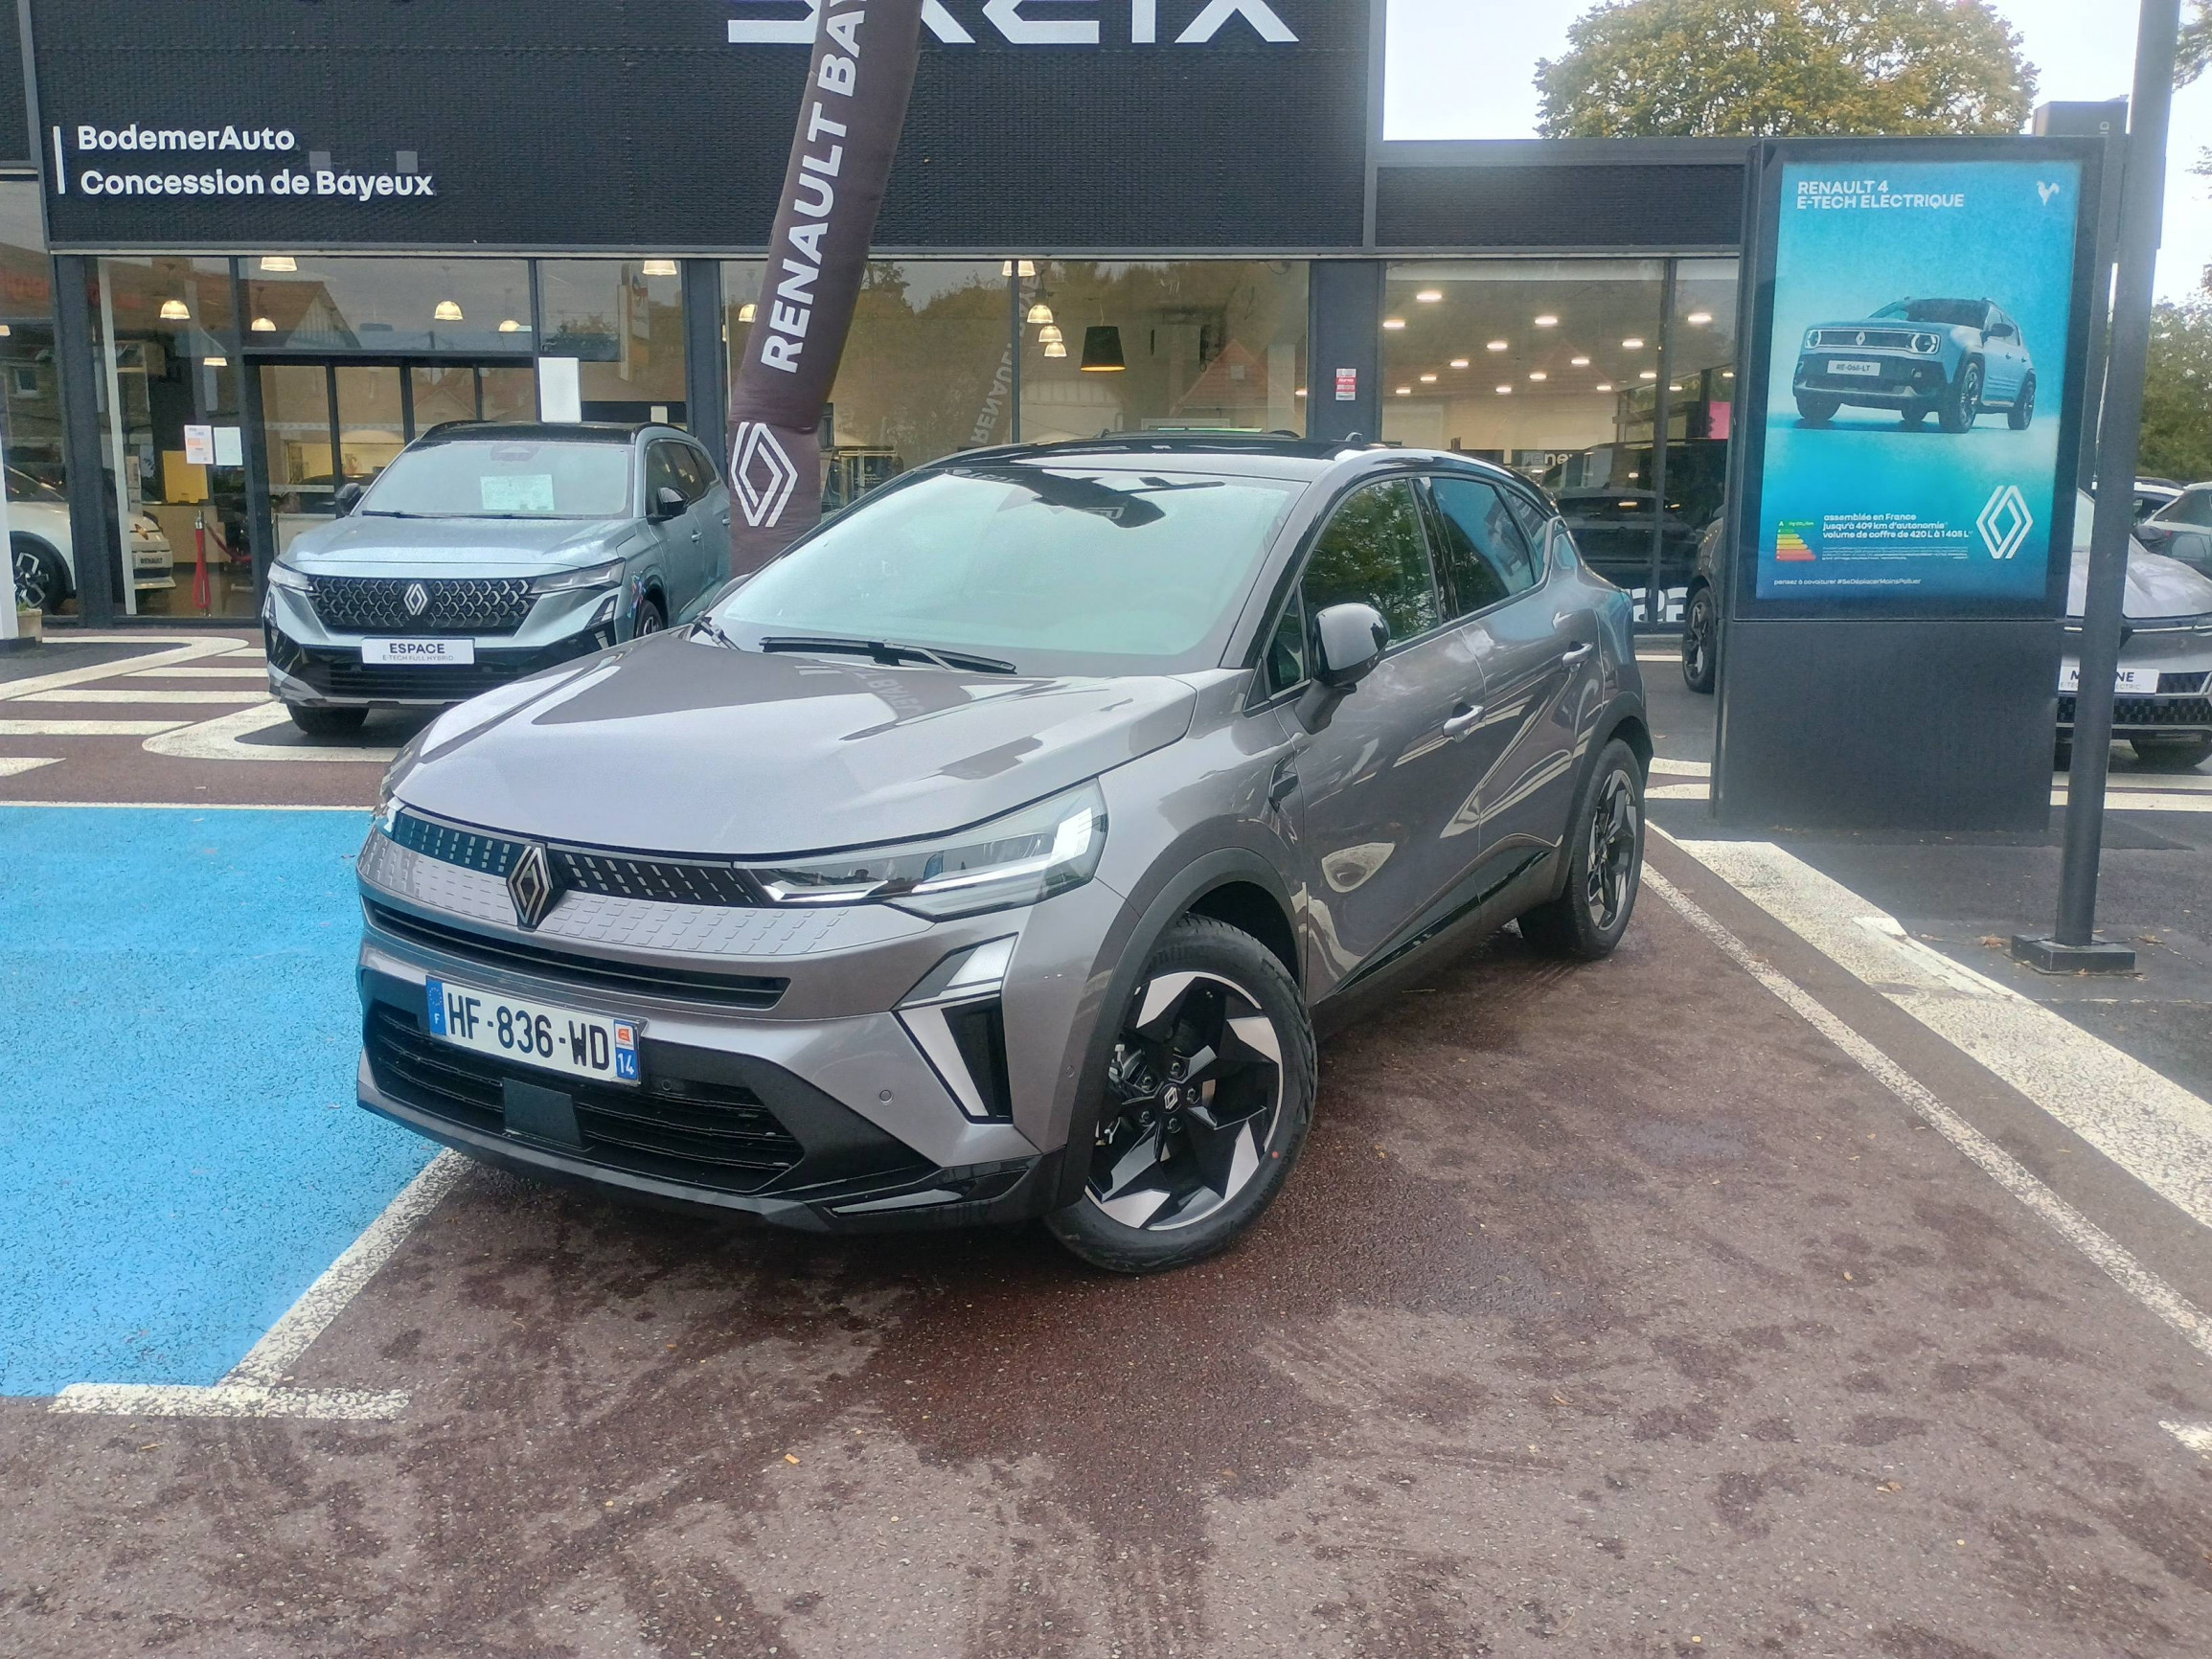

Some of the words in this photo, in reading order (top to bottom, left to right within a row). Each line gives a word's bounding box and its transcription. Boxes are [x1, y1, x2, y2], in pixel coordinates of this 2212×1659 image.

[78, 125, 295, 150] BodemerAuto
[80, 170, 265, 195] Concession
[270, 170, 311, 195] de
[316, 170, 434, 201] Bayeux
[1797, 181, 1876, 194] RENAULT
[1878, 180, 1888, 193] 4
[1797, 195, 1857, 209] E-TECH
[1860, 193, 1965, 209] ELECTRIQUE
[761, 102, 847, 374] RENAULT
[389, 643, 445, 654] ESPACE
[447, 992, 609, 1070] HF-836-WD
[618, 1053, 634, 1075] 14
